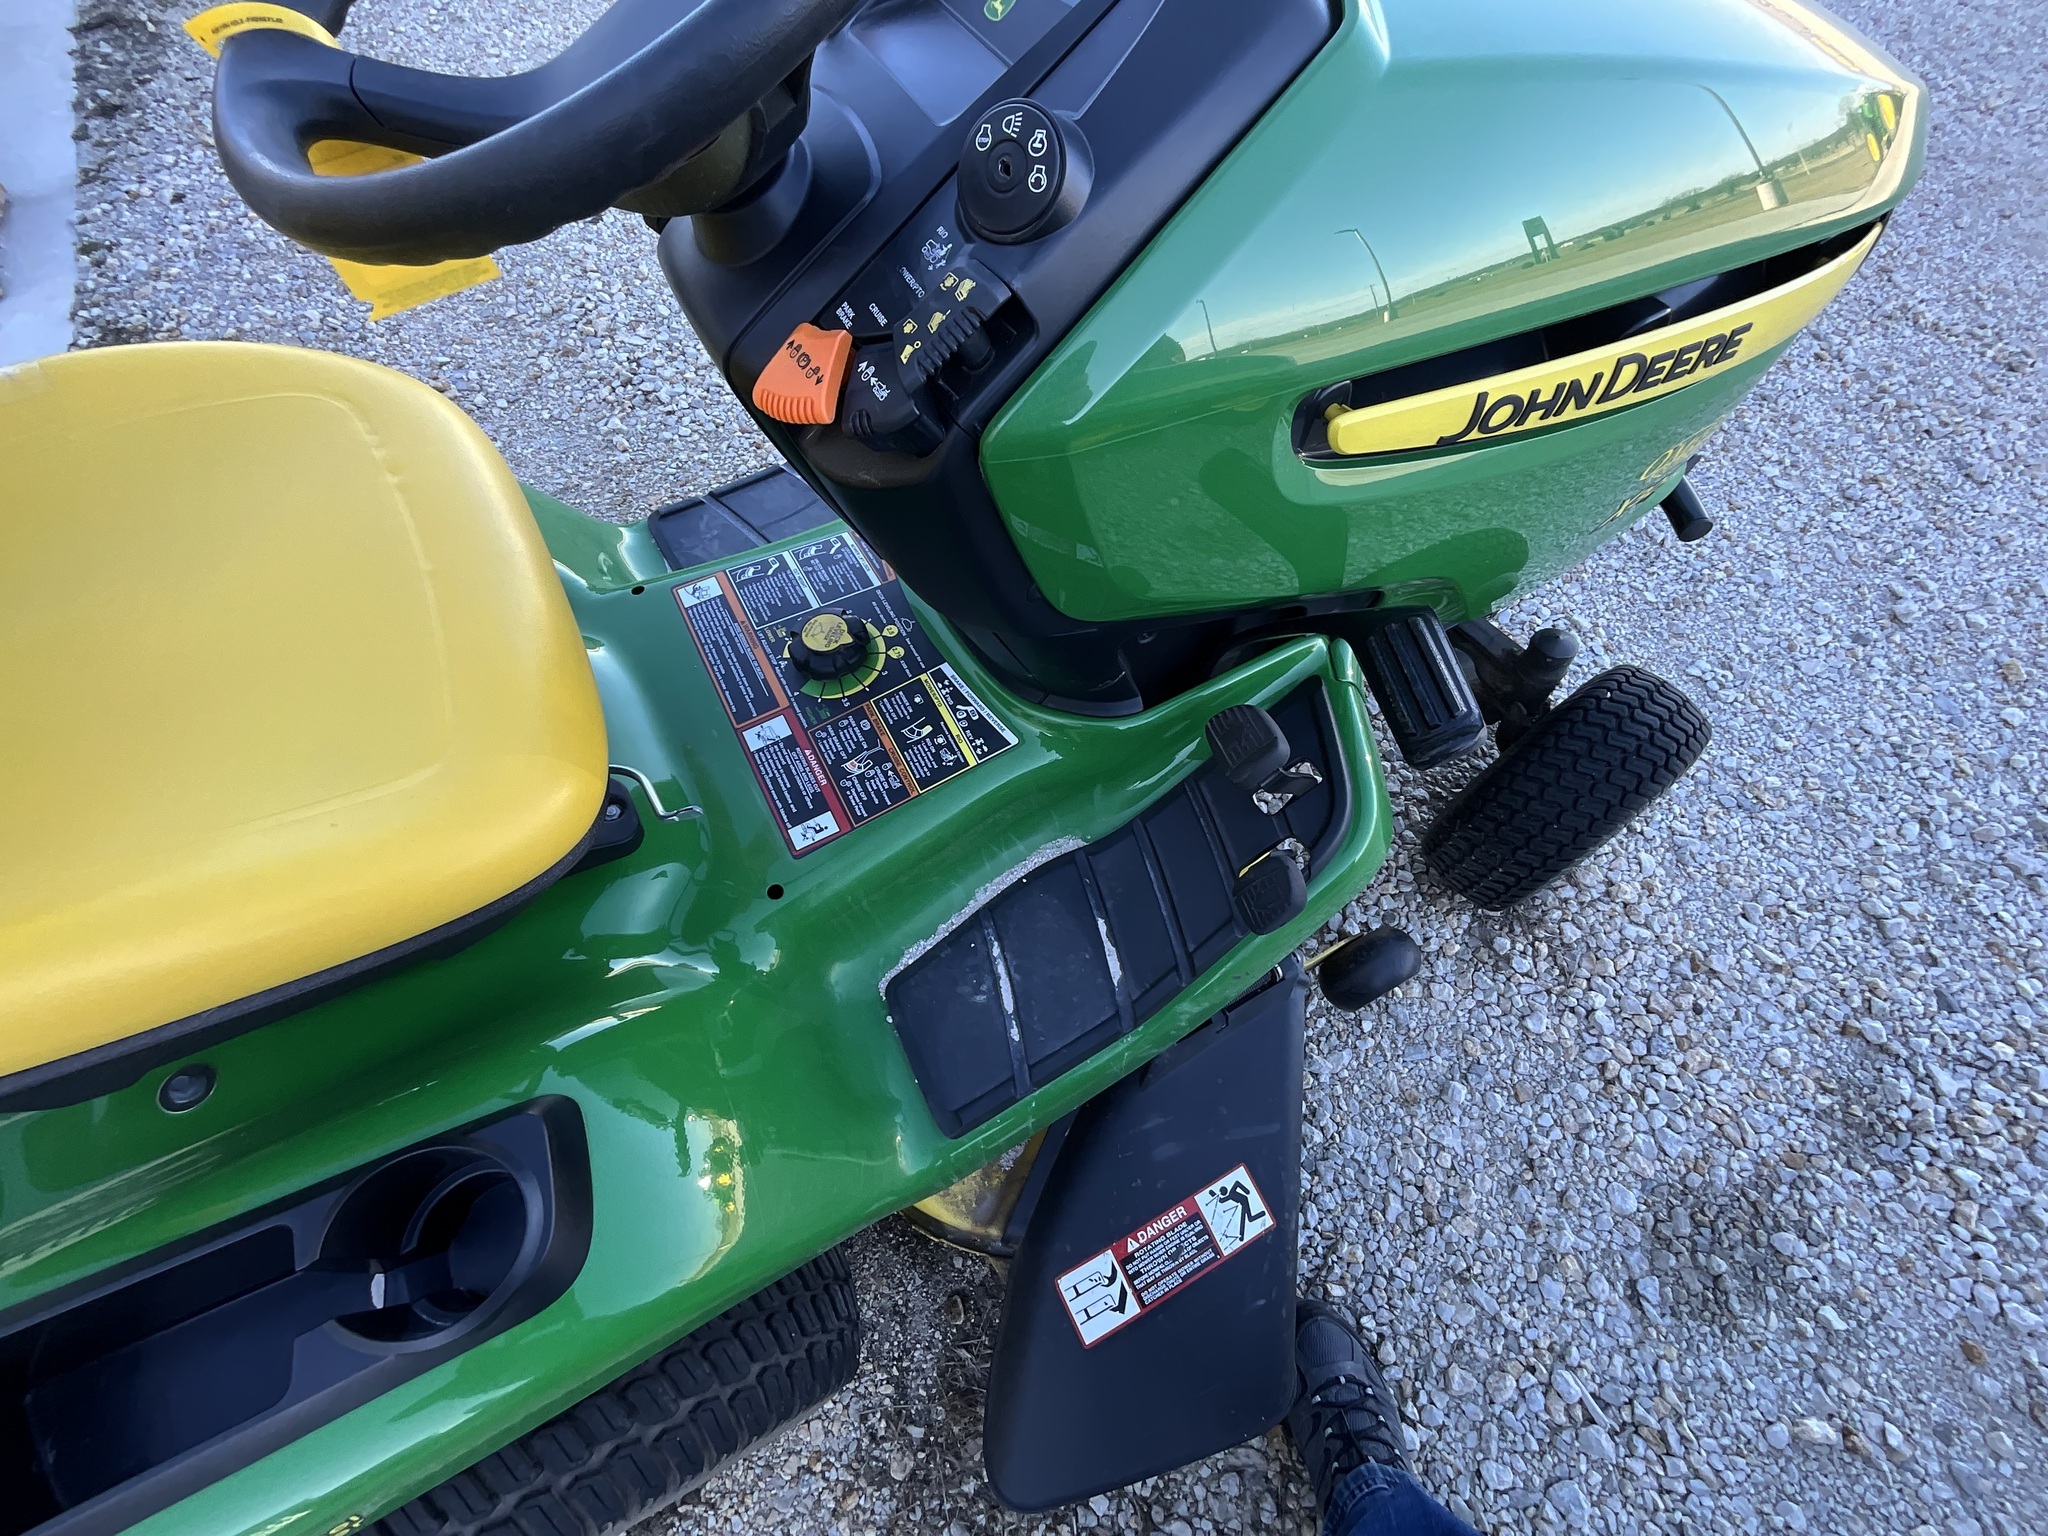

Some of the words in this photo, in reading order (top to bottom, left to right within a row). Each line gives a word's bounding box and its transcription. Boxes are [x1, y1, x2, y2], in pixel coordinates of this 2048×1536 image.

[935, 225, 948, 239] RIO
[896, 263, 925, 298] OWER/PTO
[834, 307, 853, 329] BRAKE
[840, 301, 855, 319] PARK
[867, 302, 888, 326] CRUISE
[1437, 371, 1604, 447] JOHN
[1602, 322, 1753, 402] DEERE
[875, 589, 884, 600] DECK
[882, 599, 895, 618] LEVELING
[893, 617, 906, 636] POSITION
[742, 623, 758, 649] WARNING
[764, 626, 775, 643] LOWER
[824, 621, 843, 648] LEVELING
[832, 628, 846, 644] DECK
[841, 697, 850, 707] 3.5
[944, 694, 954, 705] FWD
[950, 673, 966, 689] BRAKE
[964, 690, 985, 711] FORWARD
[985, 712, 1005, 733] REVERSE
[847, 715, 856, 727] PARK
[853, 726, 863, 741] BRAKE
[864, 703, 875, 717] PARK
[872, 718, 885, 736] BRAKE
[826, 724, 835, 736] PARK
[832, 735, 842, 750] BRAKE
[954, 733, 963, 743] RIO
[964, 729, 974, 740] REV
[807, 754, 827, 786] DANGER
[874, 765, 885, 781] CRUISE
[888, 747, 901, 766] CRUISE
[899, 767, 916, 793] CONTROL
[851, 776, 862, 792] CRUISE
[1136, 1205, 1187, 1244] DANGER
[1133, 1234, 1166, 1258] ROTATING
[1165, 1221, 1187, 1238] BLADE
[1139, 1253, 1168, 1274] THROWN
